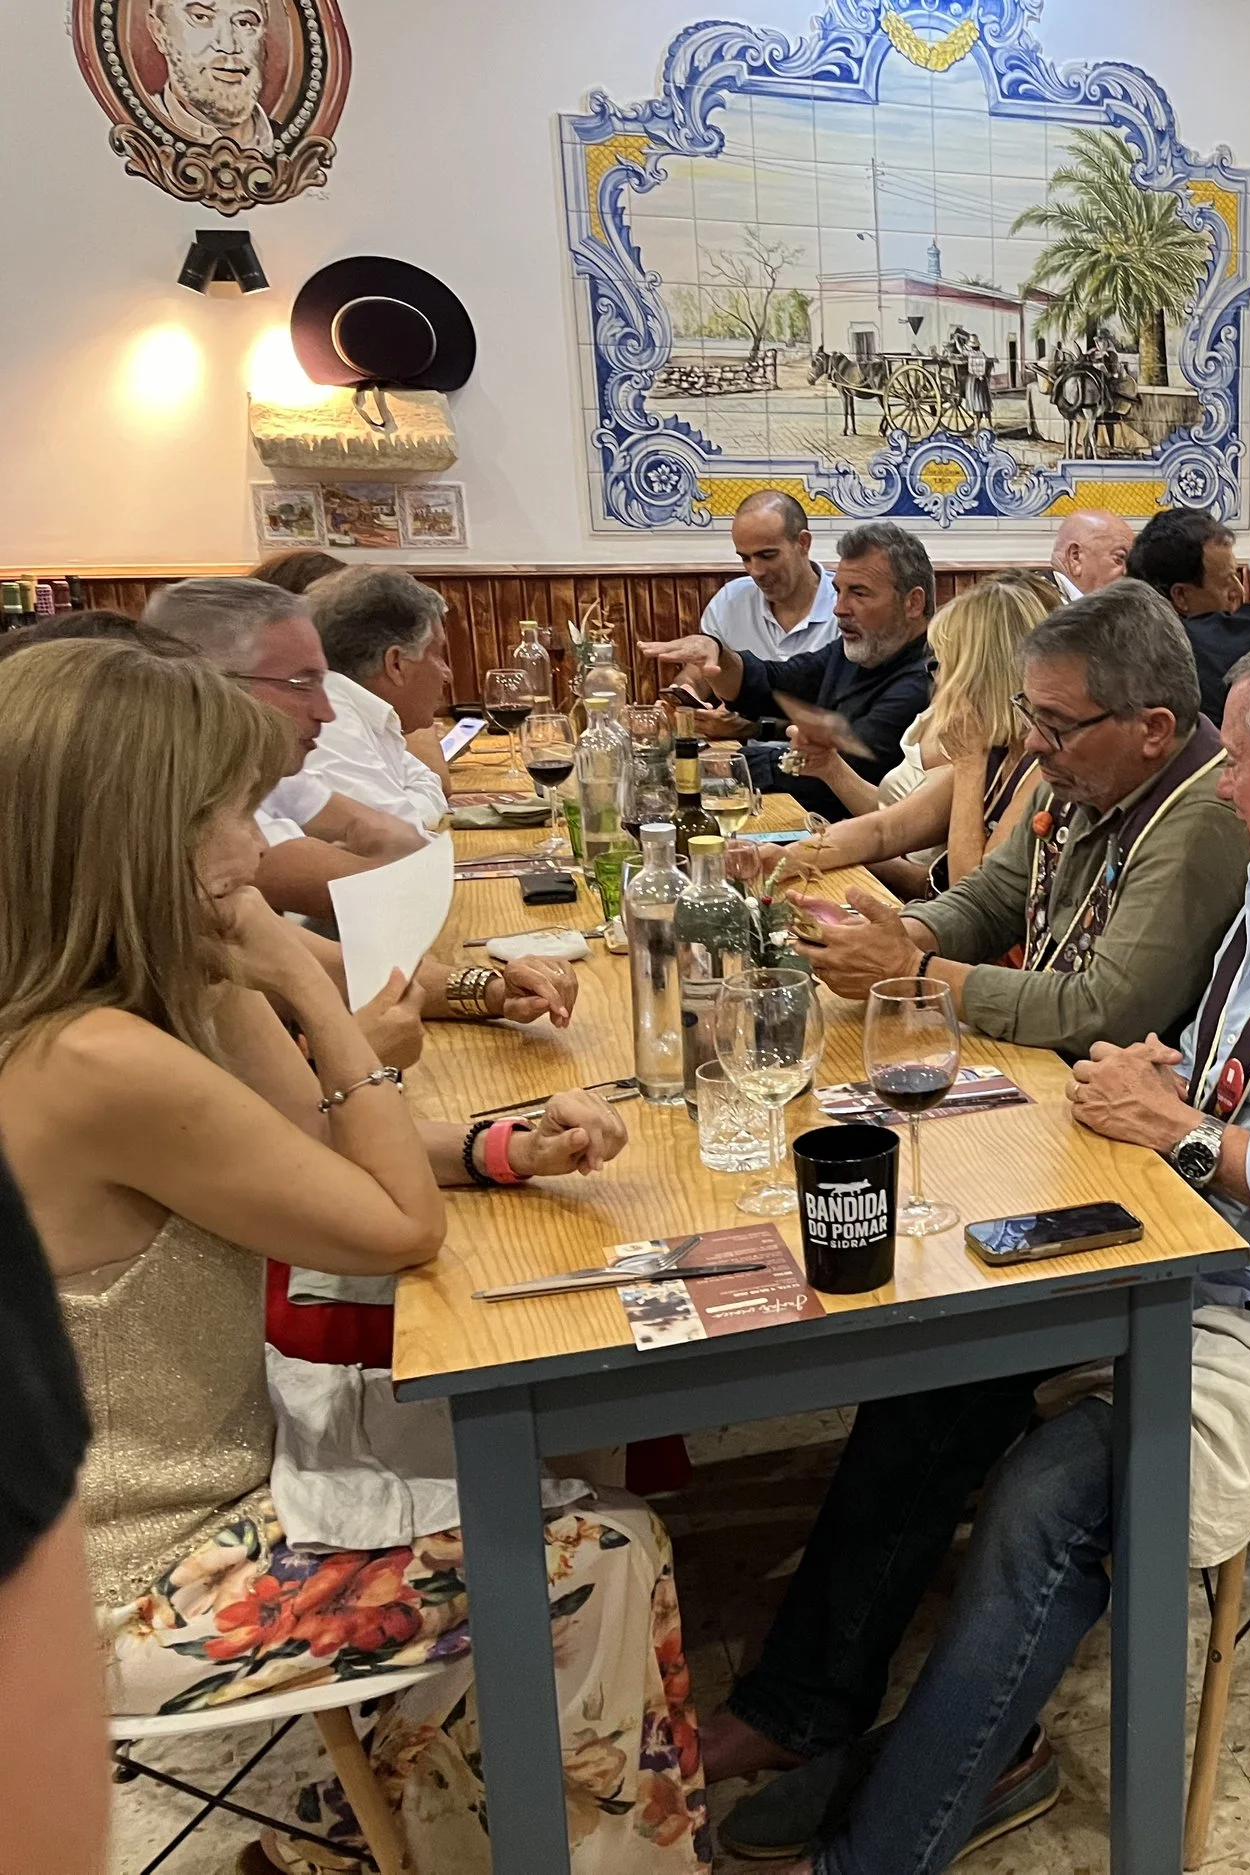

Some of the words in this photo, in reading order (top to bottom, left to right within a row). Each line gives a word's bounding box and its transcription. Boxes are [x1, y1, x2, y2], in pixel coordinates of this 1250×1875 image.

[805, 1189, 888, 1223] BANDIDA
[808, 1219, 827, 1239] DO
[832, 1215, 888, 1240] POMAR
[830, 1238, 867, 1249] SIDRA
